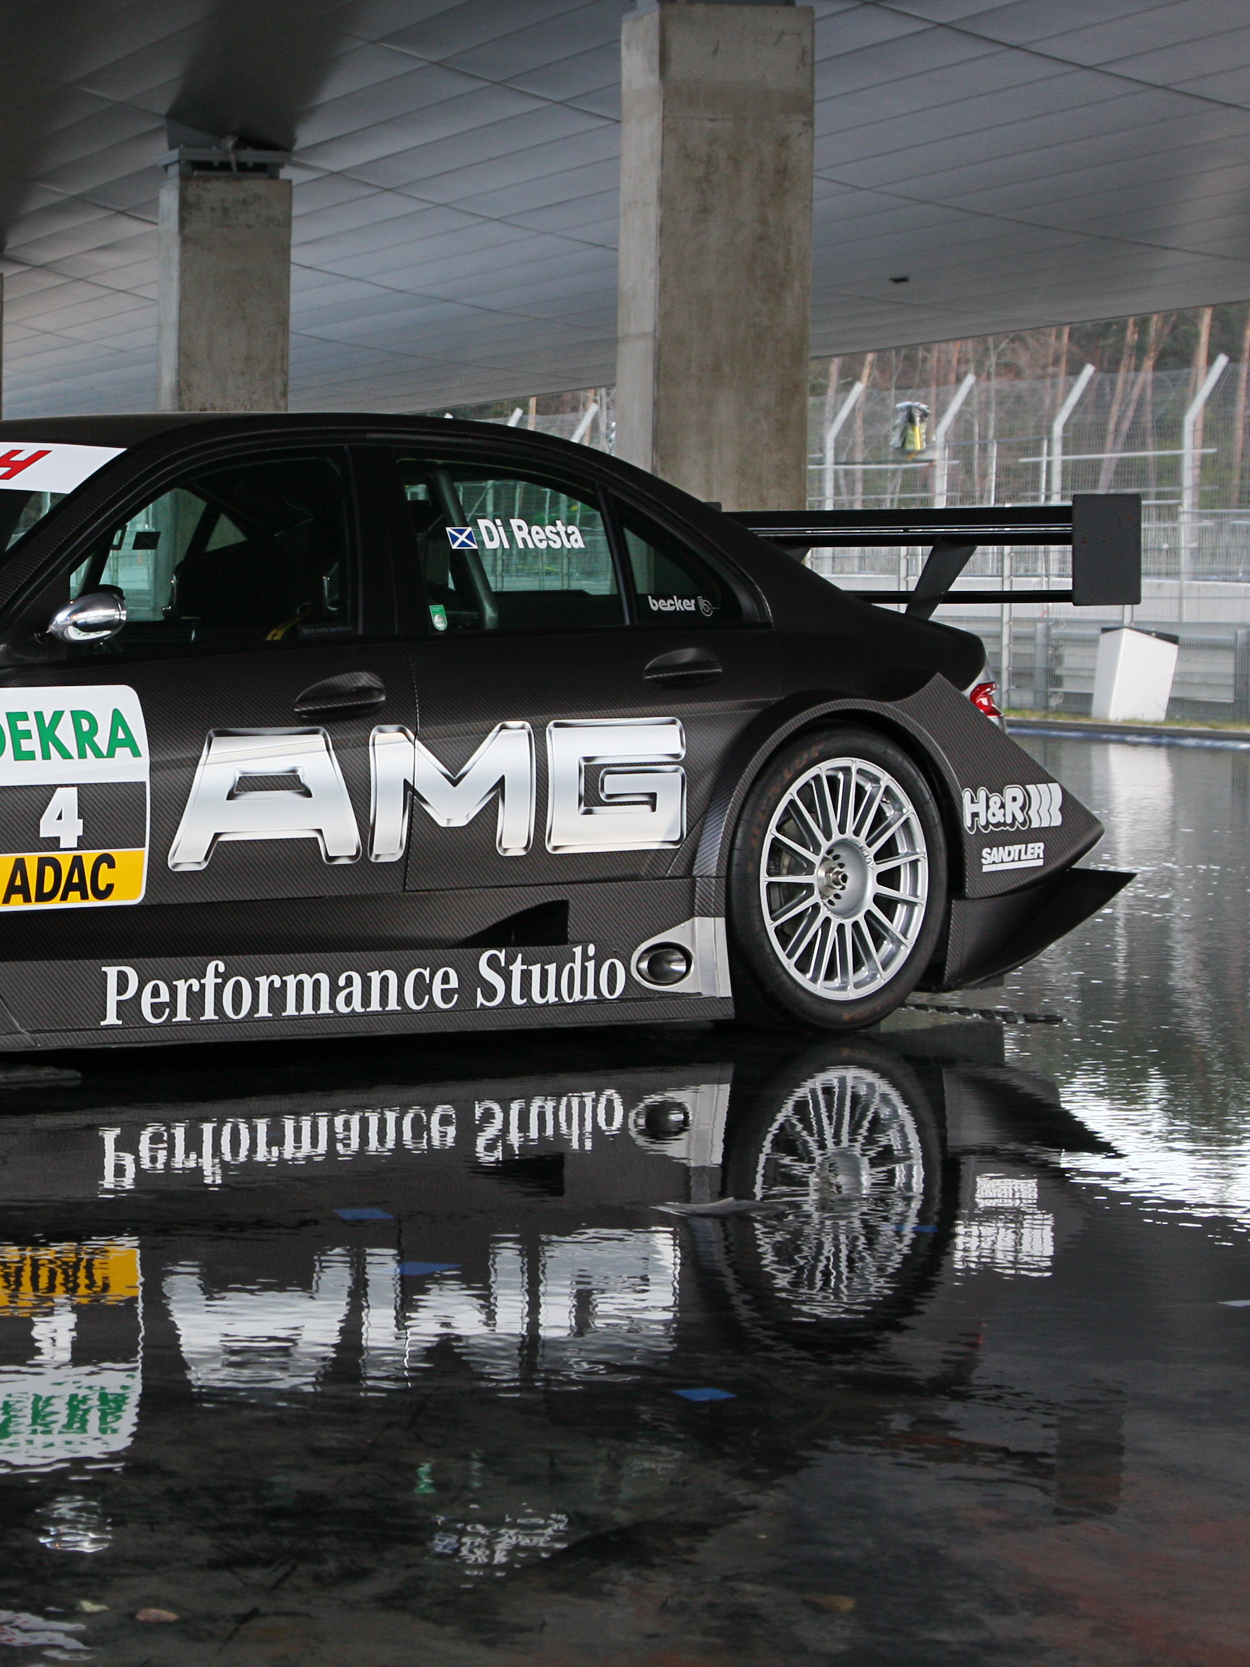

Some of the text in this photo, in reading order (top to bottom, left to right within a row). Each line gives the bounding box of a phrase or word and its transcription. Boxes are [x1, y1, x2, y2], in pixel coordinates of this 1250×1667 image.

[476, 518, 585, 550] Di Resta
[648, 595, 696, 612] becker
[38, 786, 84, 849] 4
[166, 716, 688, 872] AMG
[962, 784, 1029, 835] H&R
[2, 852, 117, 905] ADAC
[981, 842, 1044, 865] SANDTLER
[100, 943, 626, 1028] Performance Studio
